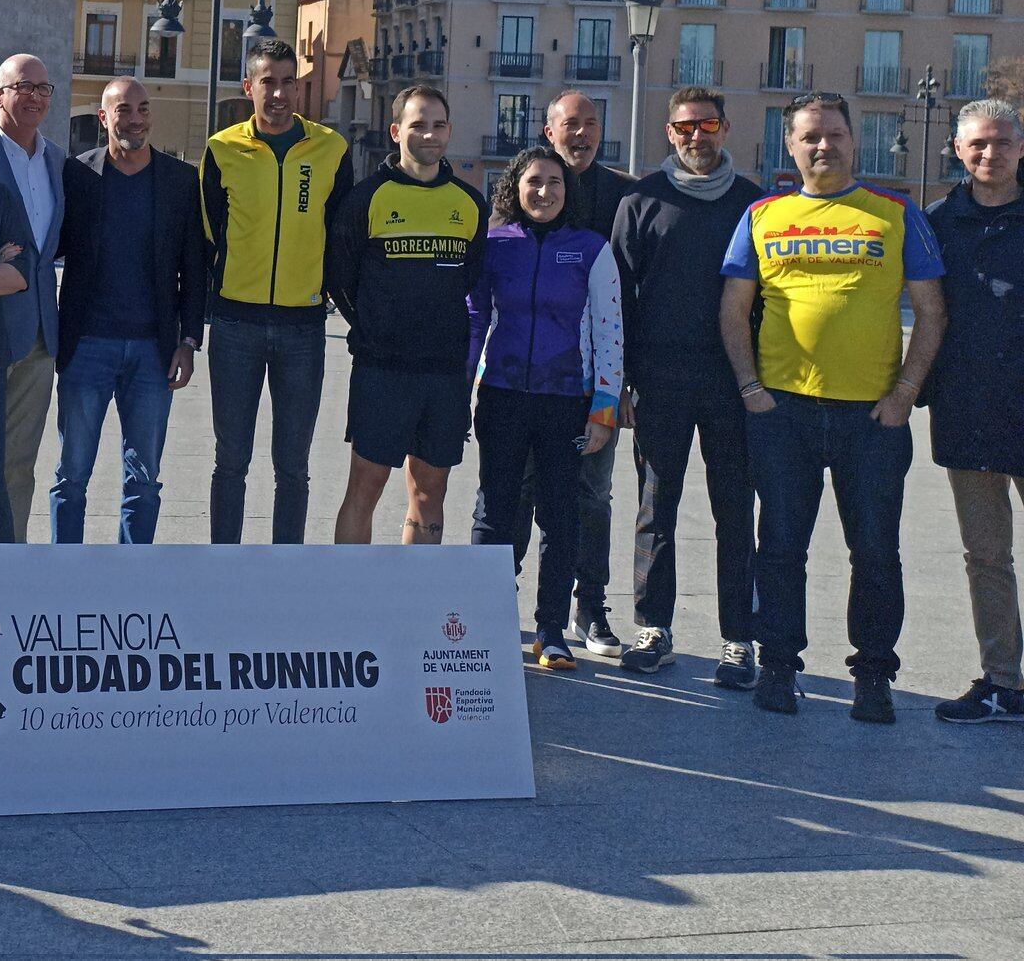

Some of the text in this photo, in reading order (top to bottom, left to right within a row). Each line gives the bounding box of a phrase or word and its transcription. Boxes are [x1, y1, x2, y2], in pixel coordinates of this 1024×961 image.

[384, 239, 467, 254] CORRECAMINOS
[764, 238, 885, 259] runners
[769, 256, 883, 267] CIUTAT DE VALENCIA
[10, 613, 181, 652] VALENCIA
[423, 649, 490, 659] AJUNTAMENT
[12, 650, 380, 694] CIUDAD DEL RUNNING
[423, 660, 492, 673] DE VALÈNCIA
[455, 688, 491, 696] Fundació
[455, 698, 494, 707] Esportiva
[19, 699, 358, 733] 10 años corriendo por Valencia
[456, 705, 495, 714] Municipal
